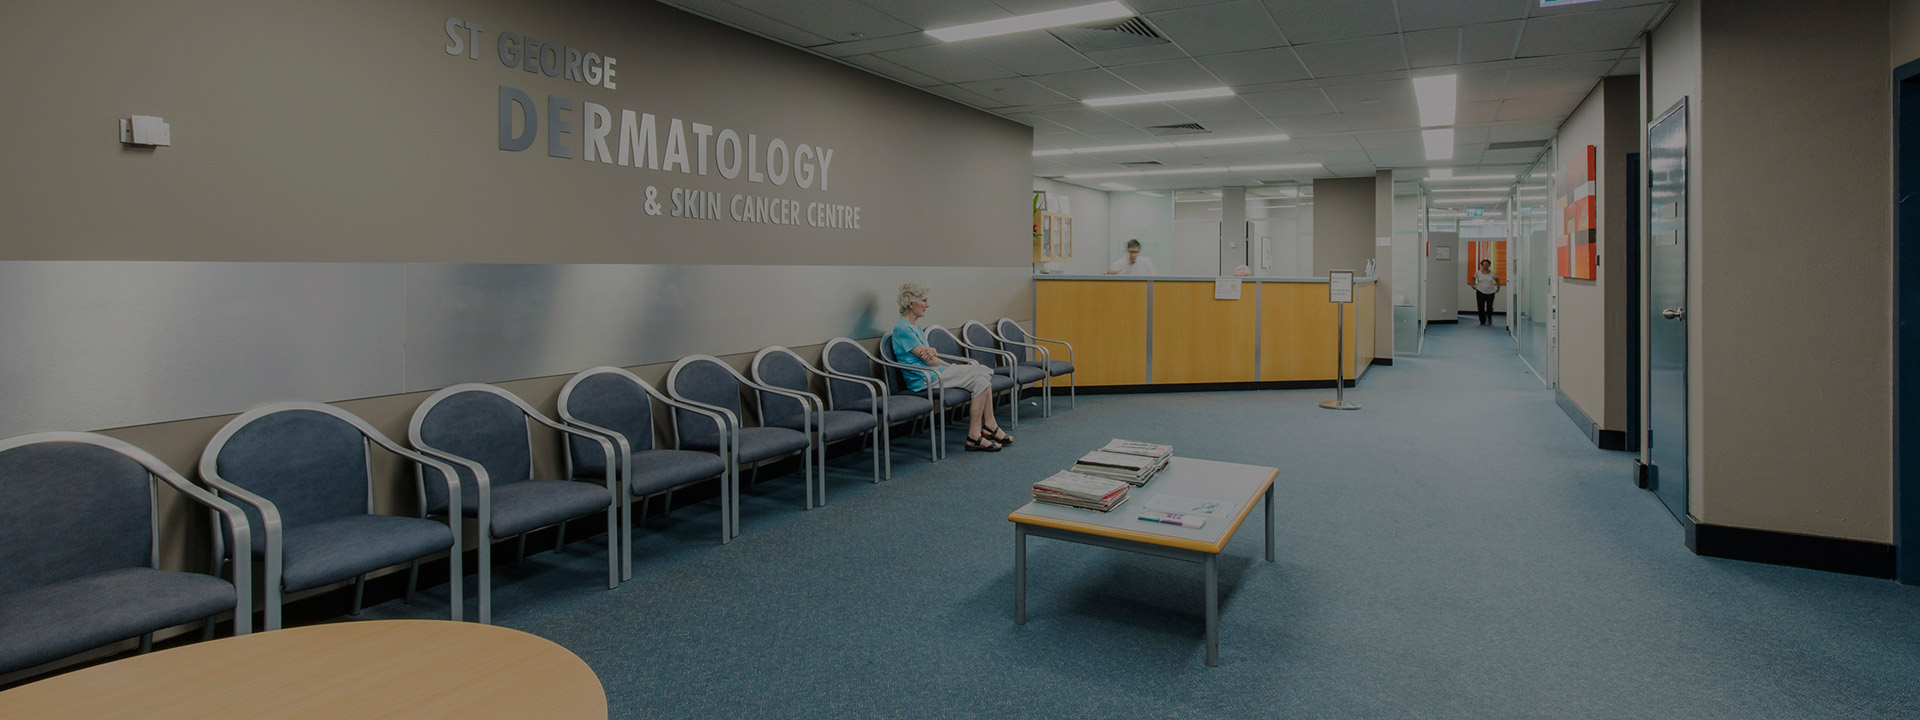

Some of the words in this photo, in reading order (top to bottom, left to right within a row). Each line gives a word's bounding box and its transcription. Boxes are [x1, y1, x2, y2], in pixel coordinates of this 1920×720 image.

[444, 17, 484, 60] ST
[498, 30, 617, 90] GEORGE
[499, 85, 834, 191] DERMATOLOGY
[644, 186, 662, 216] &
[671, 187, 722, 221] SKIN
[730, 194, 801, 226] CANCER
[806, 202, 861, 230] CENTRE
